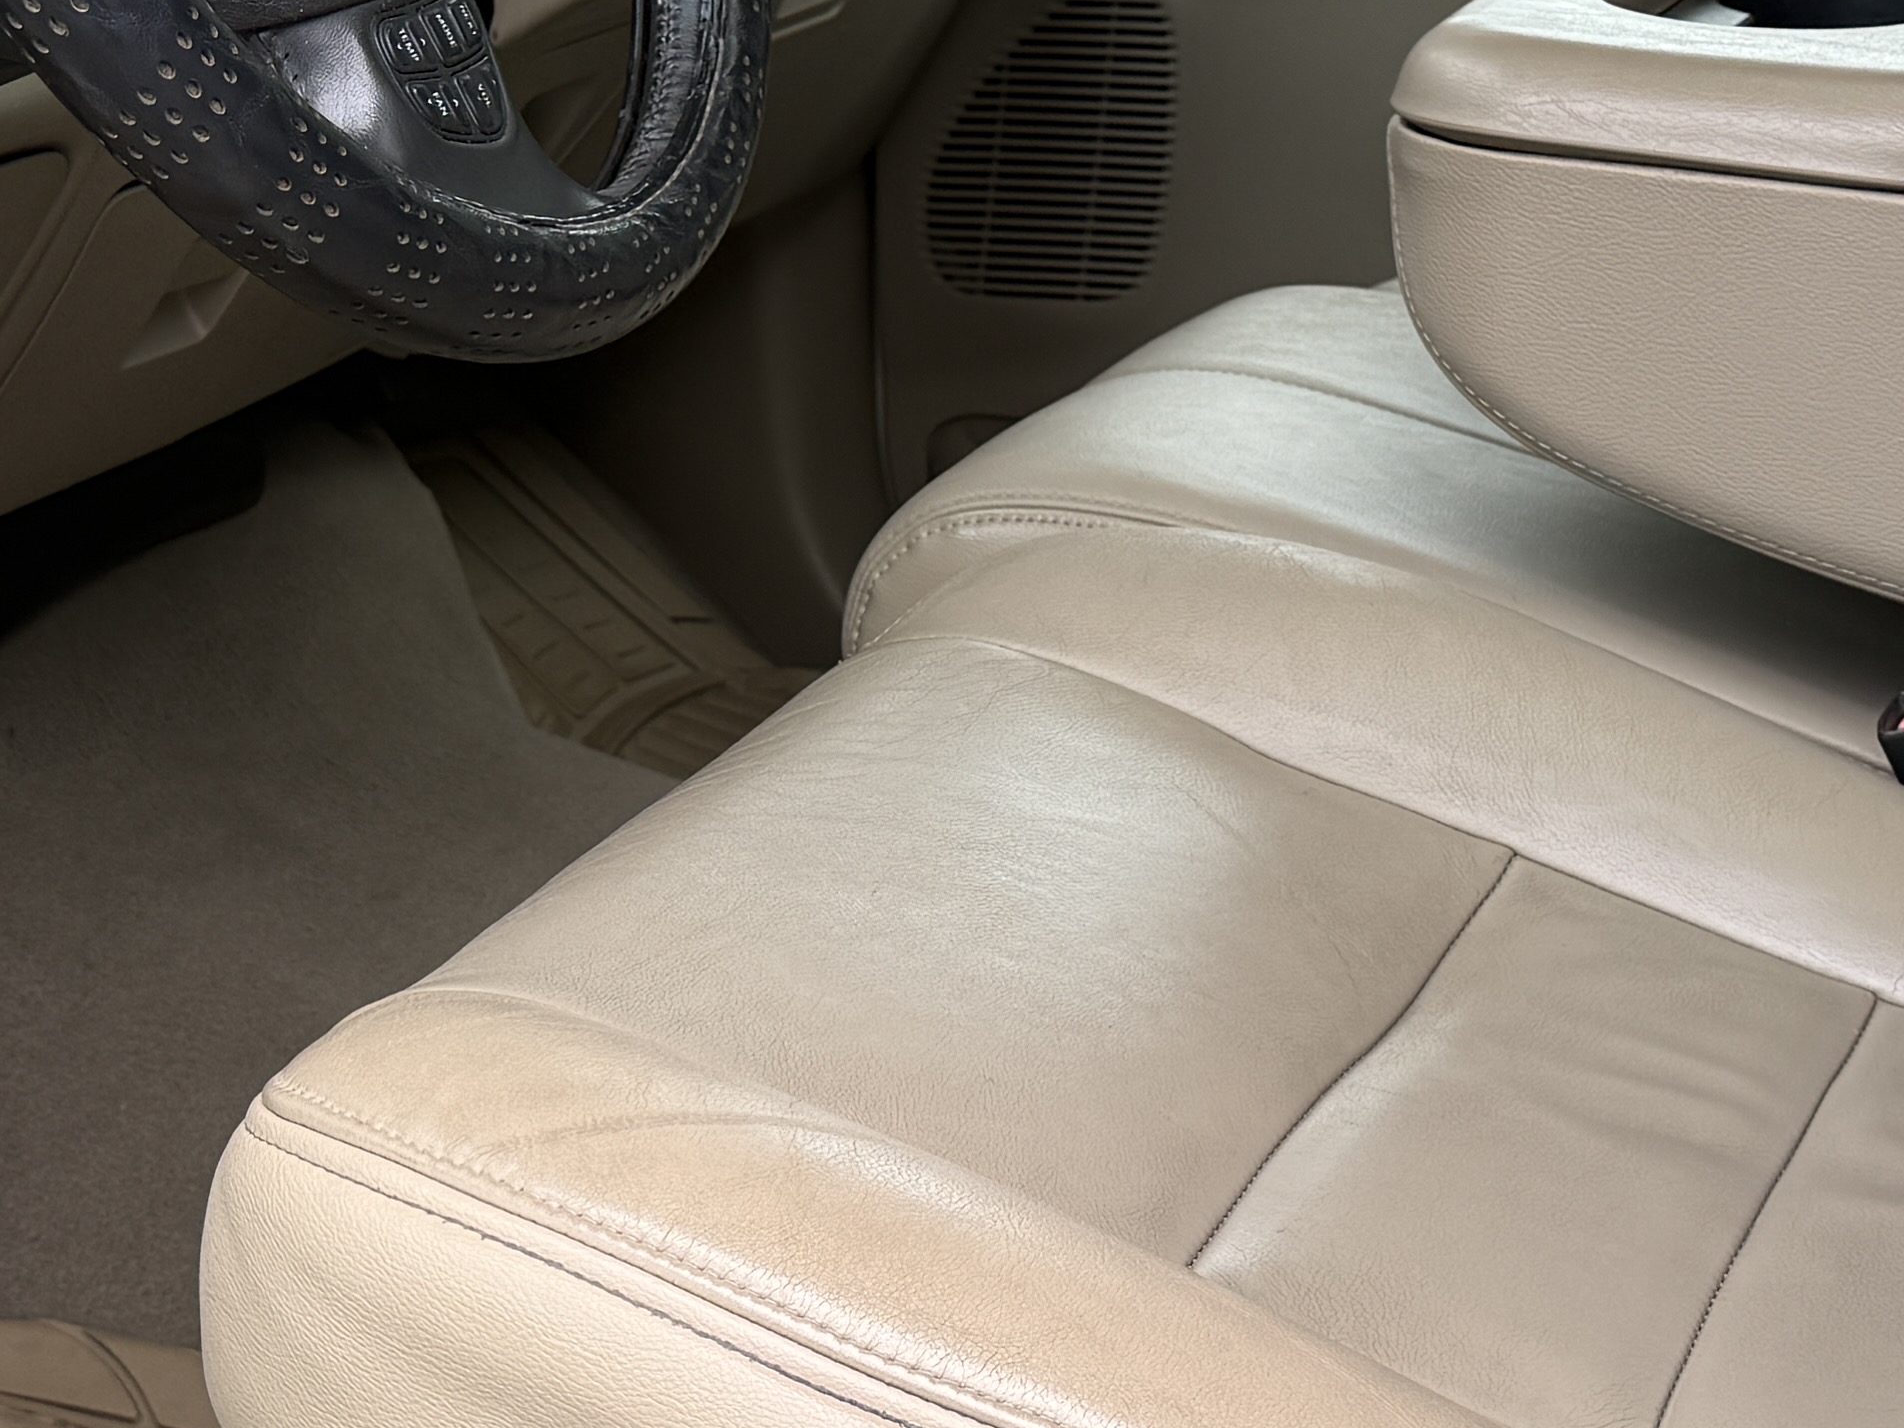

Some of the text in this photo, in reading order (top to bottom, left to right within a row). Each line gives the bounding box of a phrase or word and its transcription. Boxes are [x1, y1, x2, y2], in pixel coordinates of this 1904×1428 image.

[398, 28, 420, 62] TEMP
[435, 14, 457, 48] MODE
[432, 92, 448, 117] FAN
